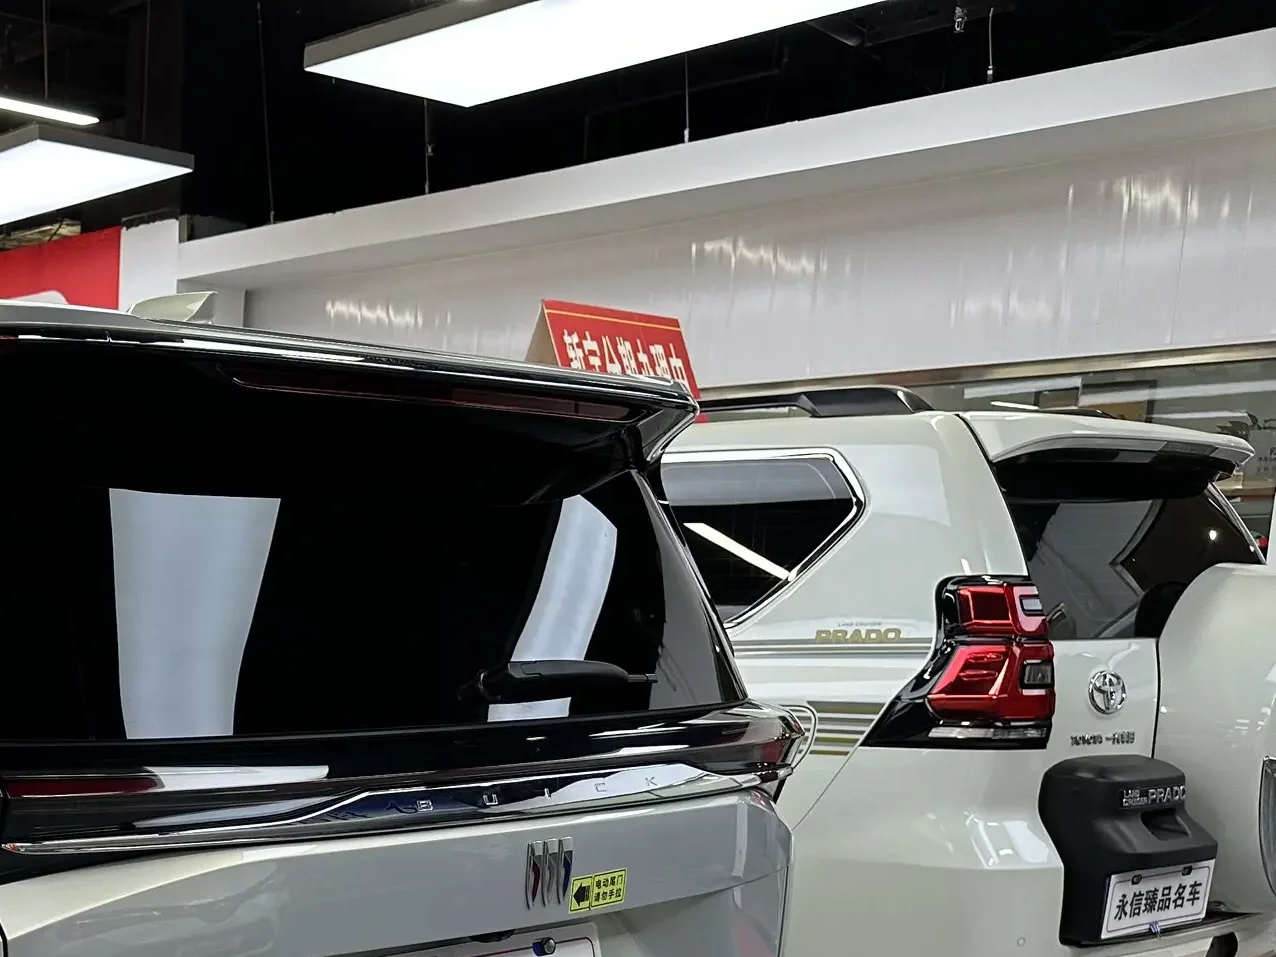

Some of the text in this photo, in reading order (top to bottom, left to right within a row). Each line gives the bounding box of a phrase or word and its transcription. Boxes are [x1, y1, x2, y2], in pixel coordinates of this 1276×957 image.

[815, 627, 902, 643] PRADO
[415, 775, 658, 811] BUICK
[1147, 785, 1186, 804] PRADO
[595, 874, 624, 890] 电动尾门
[594, 887, 623, 902] 请勿手拉
[1113, 880, 1203, 921] 永信臻品名车
